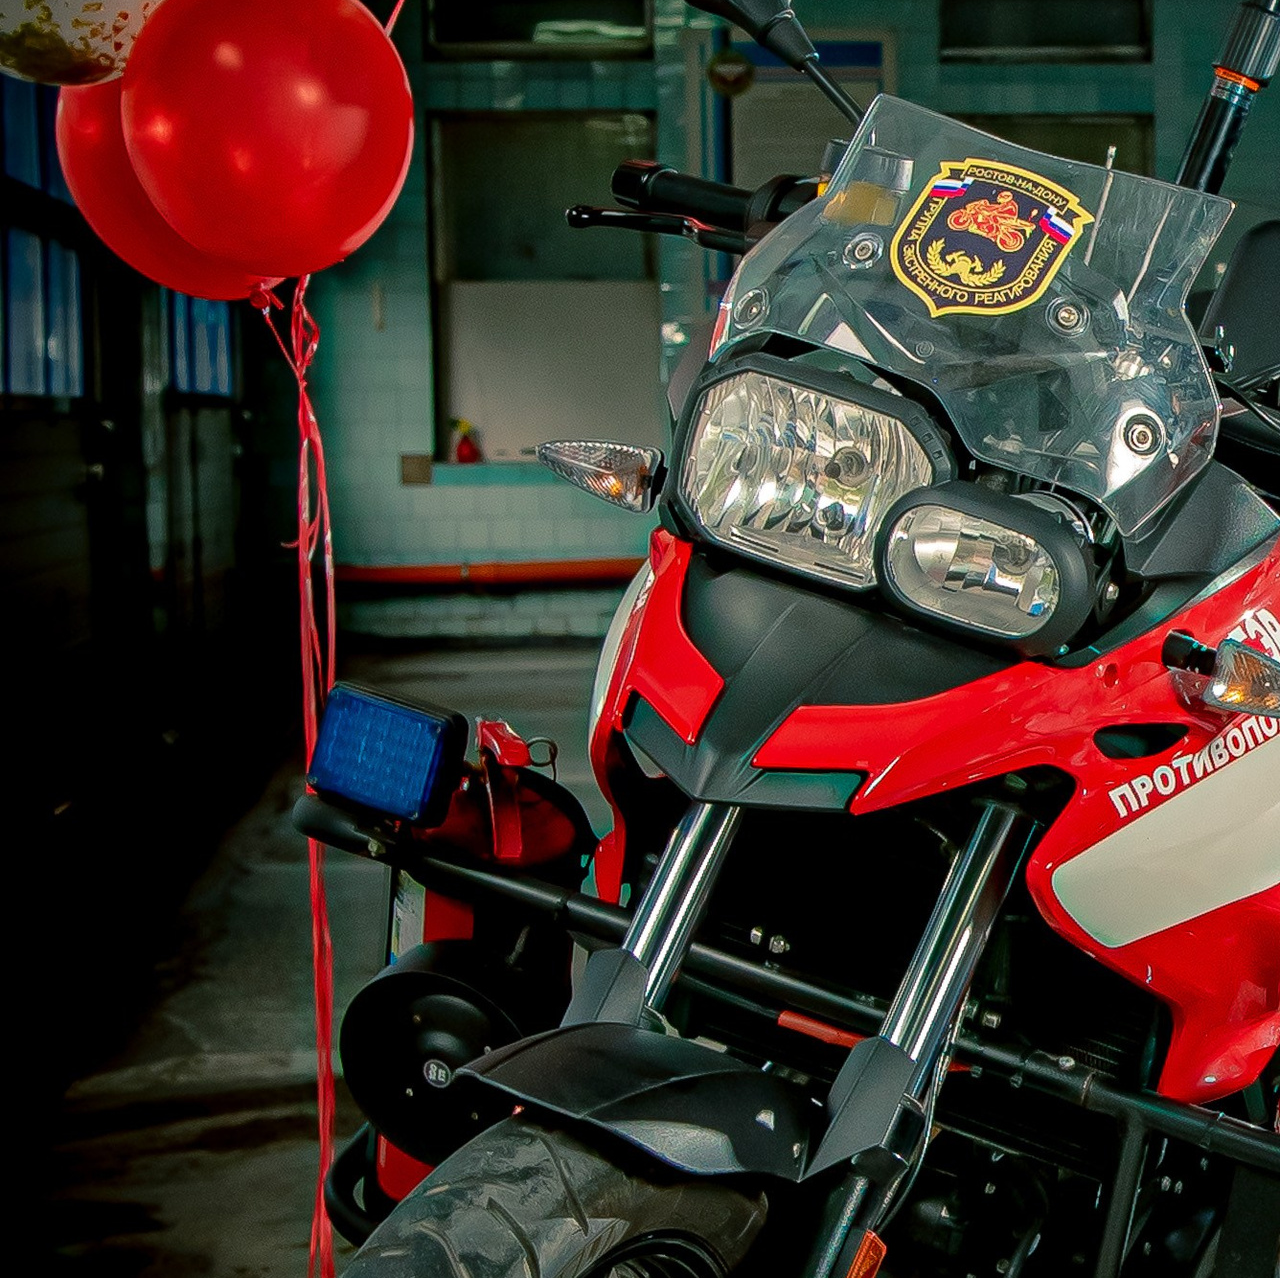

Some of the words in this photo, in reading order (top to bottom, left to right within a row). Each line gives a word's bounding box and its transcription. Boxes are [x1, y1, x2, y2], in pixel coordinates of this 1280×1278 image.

[966, 166, 1067, 208] РОСТОВ-НА-ДОНУ
[907, 196, 943, 241] ГРУППА
[902, 243, 969, 303] ЭКСТРЕННОГО
[974, 239, 1058, 305] РЕАГИРОВАНИЯ
